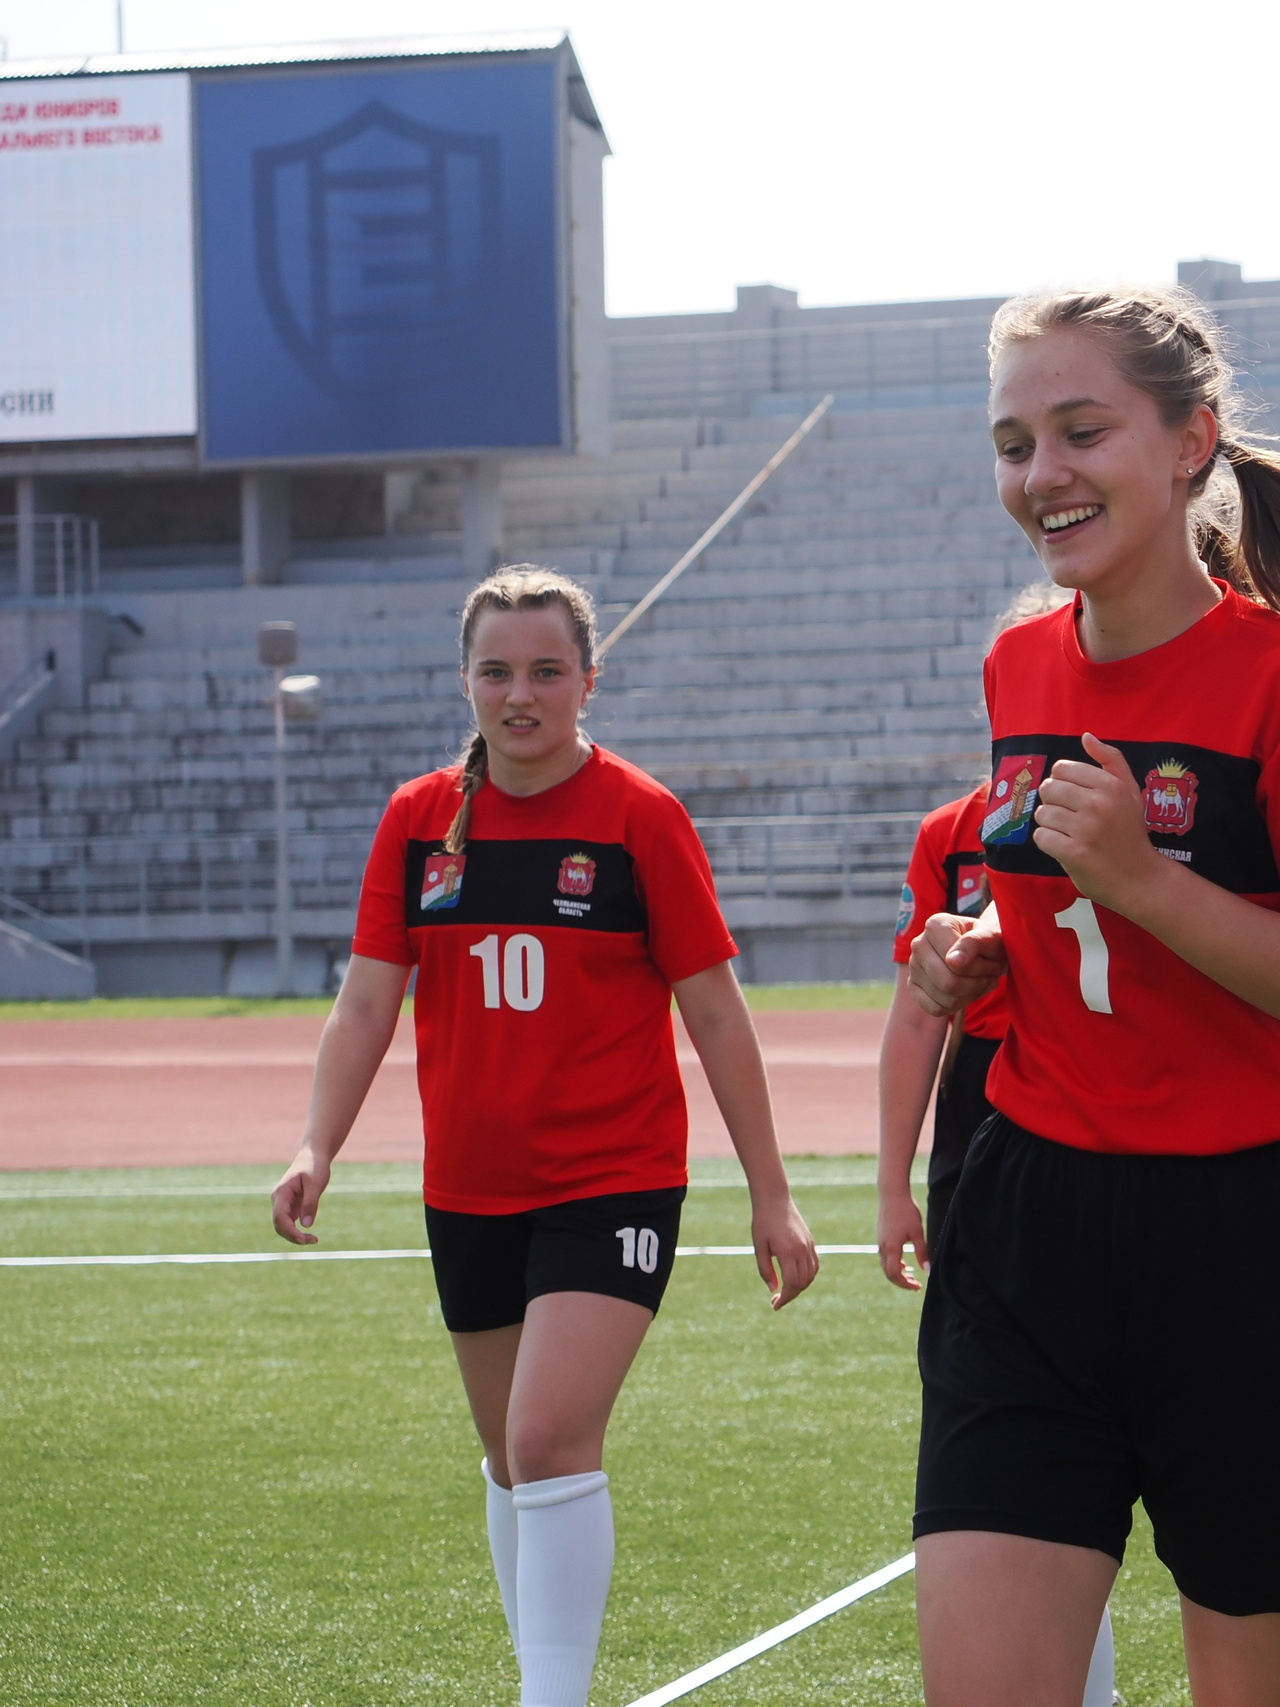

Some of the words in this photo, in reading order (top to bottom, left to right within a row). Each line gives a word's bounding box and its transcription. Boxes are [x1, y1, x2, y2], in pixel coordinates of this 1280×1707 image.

[469, 933, 545, 1012] 10
[1054, 896, 1114, 1016] 1
[615, 1226, 660, 1274] 10
